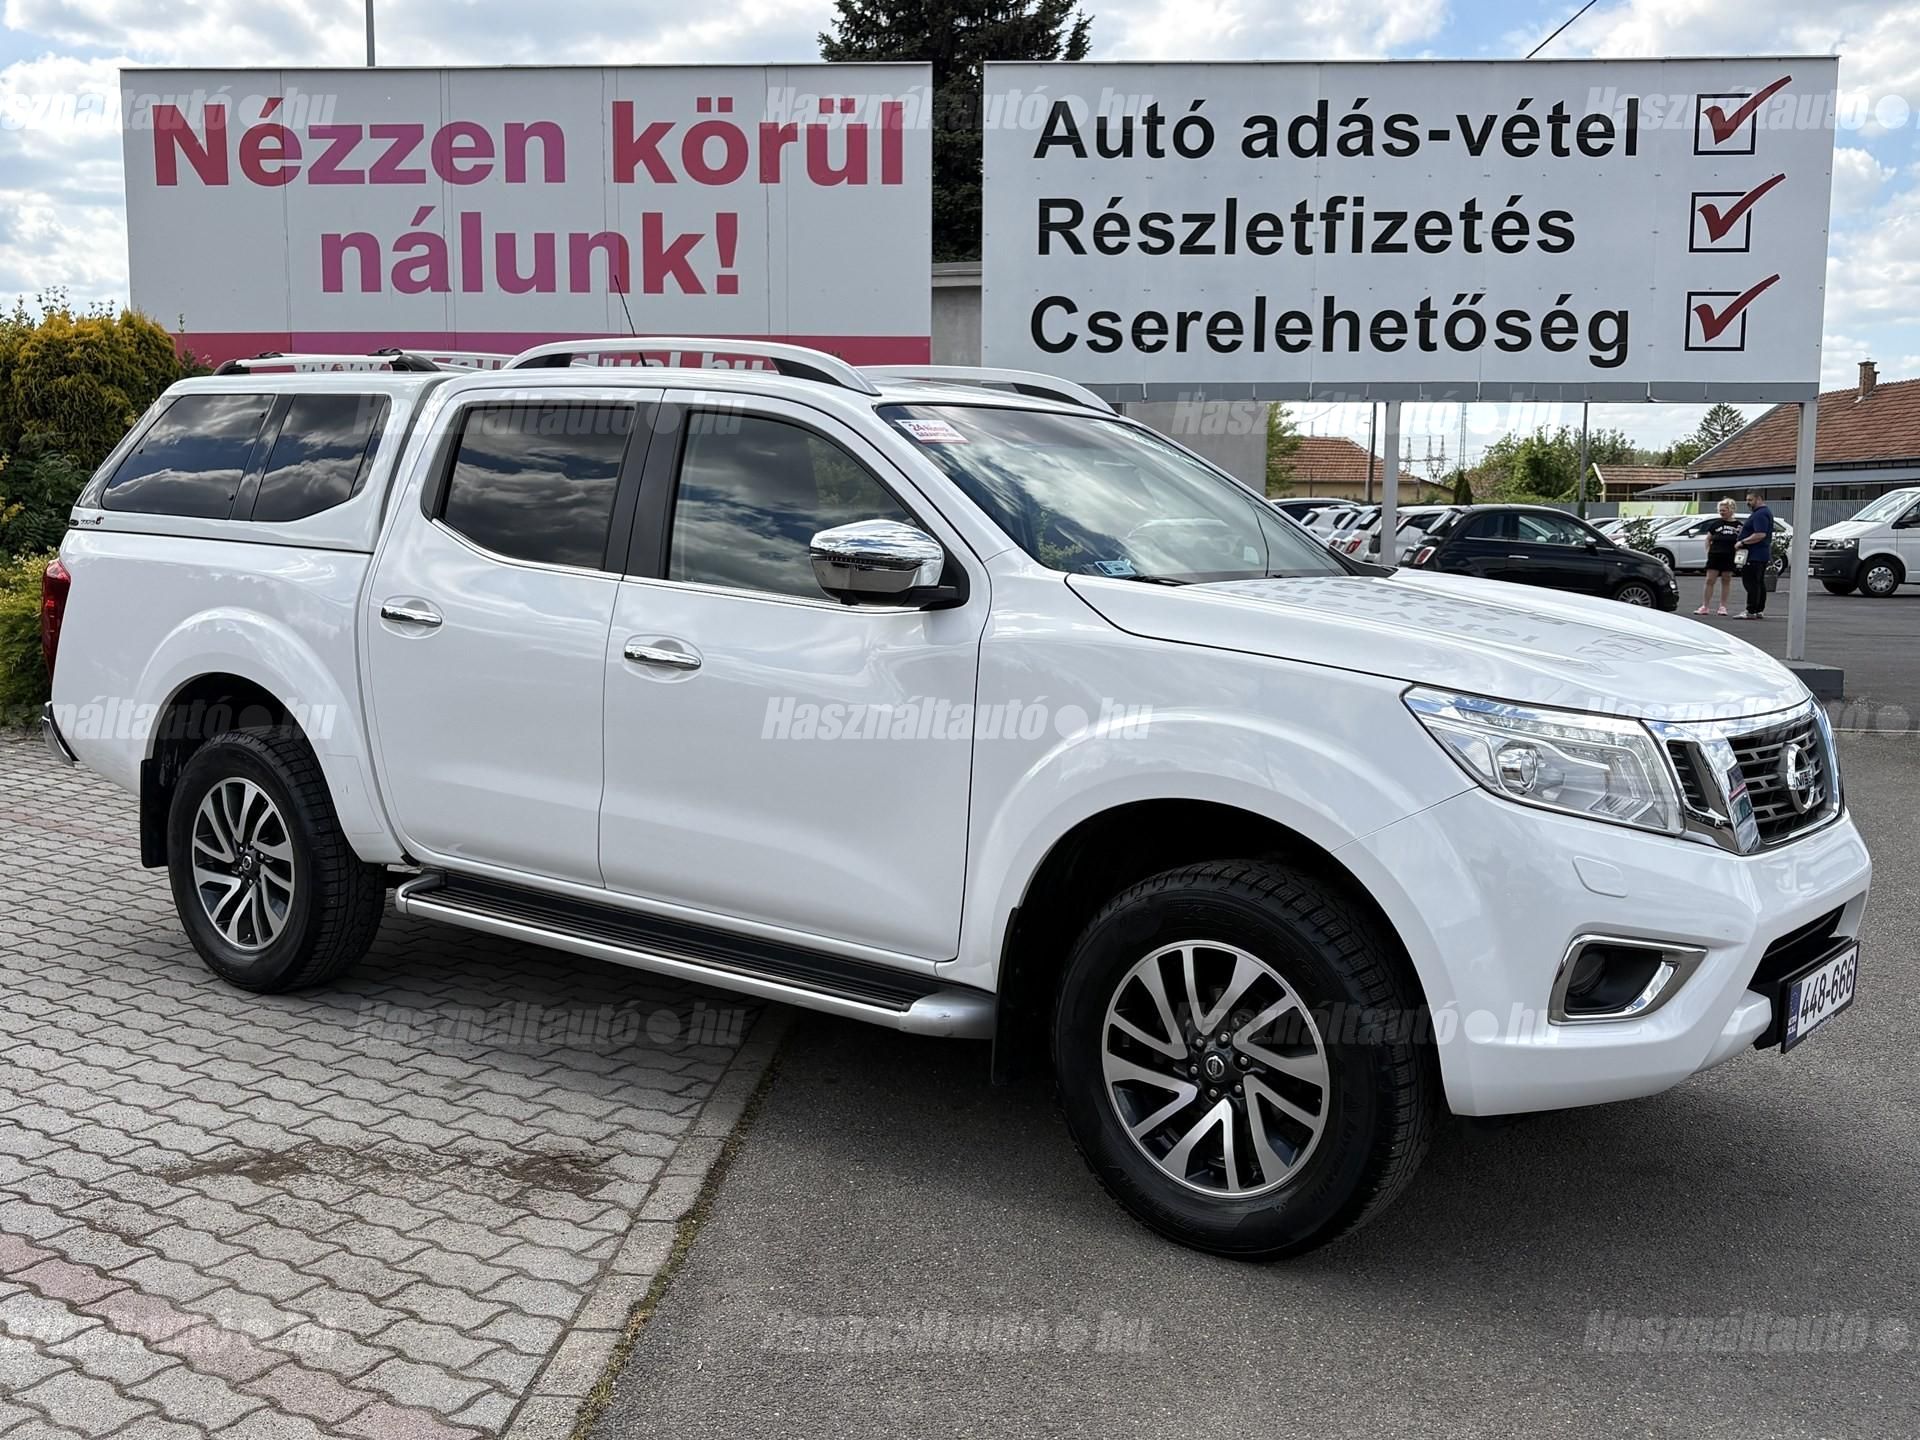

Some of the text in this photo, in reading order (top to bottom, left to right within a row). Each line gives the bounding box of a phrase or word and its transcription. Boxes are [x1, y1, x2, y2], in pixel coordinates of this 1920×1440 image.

[152, 97, 905, 187] Nézzen körül
[1032, 96, 1640, 160] Autó adás-vétel
[320, 206, 740, 295] nálunk!
[1038, 194, 1576, 257] Részletfizetés
[1029, 292, 1630, 369] Cserelehetőség
[1801, 954, 1854, 1025] 448-666
